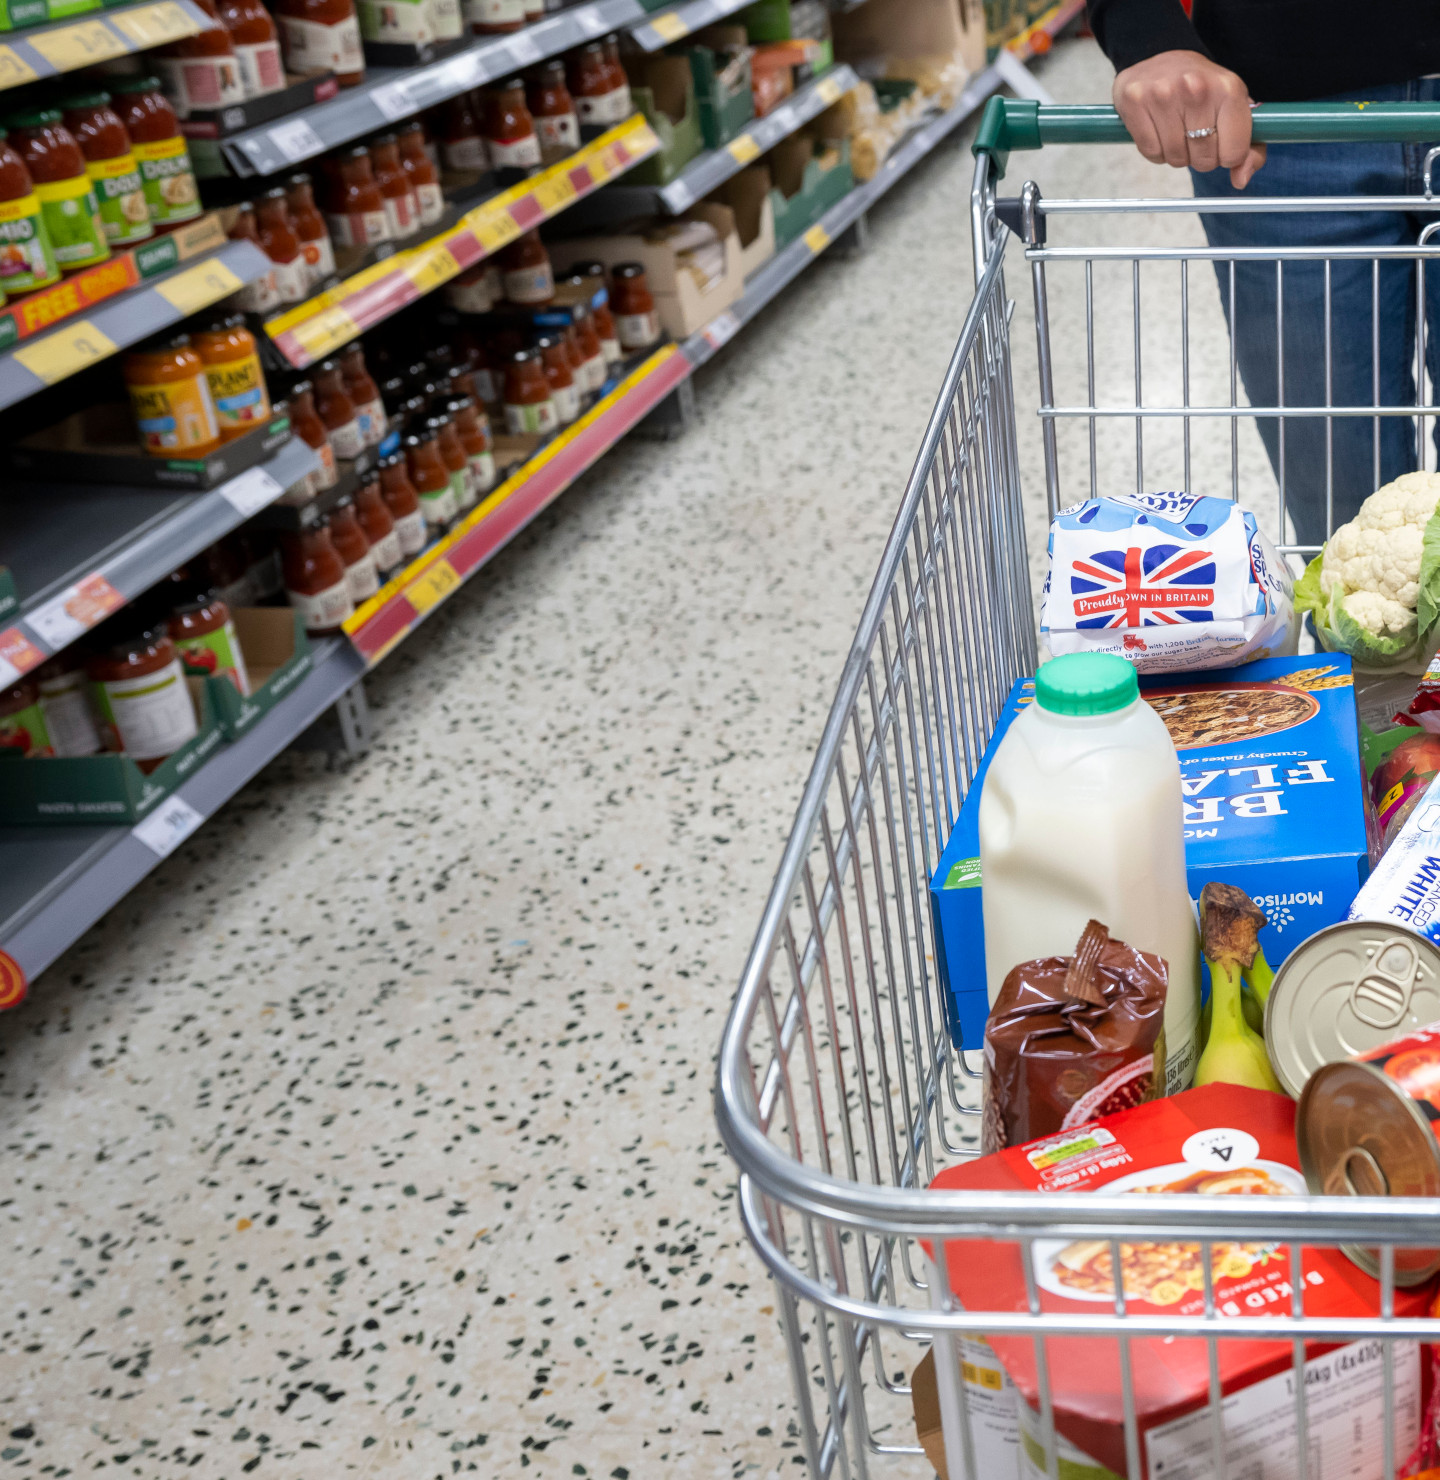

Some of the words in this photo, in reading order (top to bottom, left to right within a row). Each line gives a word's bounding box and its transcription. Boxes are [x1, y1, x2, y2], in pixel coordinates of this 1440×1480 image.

[22, 284, 80, 333] FREE
[1079, 593, 1125, 612] Proudly
[1151, 593, 1162, 602] IN
[1166, 593, 1209, 602] BRITAIN
[1149, 642, 1164, 650] with
[1165, 641, 1185, 649] 1,200
[1134, 653, 1150, 661] grow
[1164, 648, 1183, 656] sugar
[1201, 753, 1244, 764] flakes
[1246, 747, 1307, 762] Crunchy
[1211, 1145, 1233, 1162] 4
[1242, 1268, 1325, 1310] BKED
